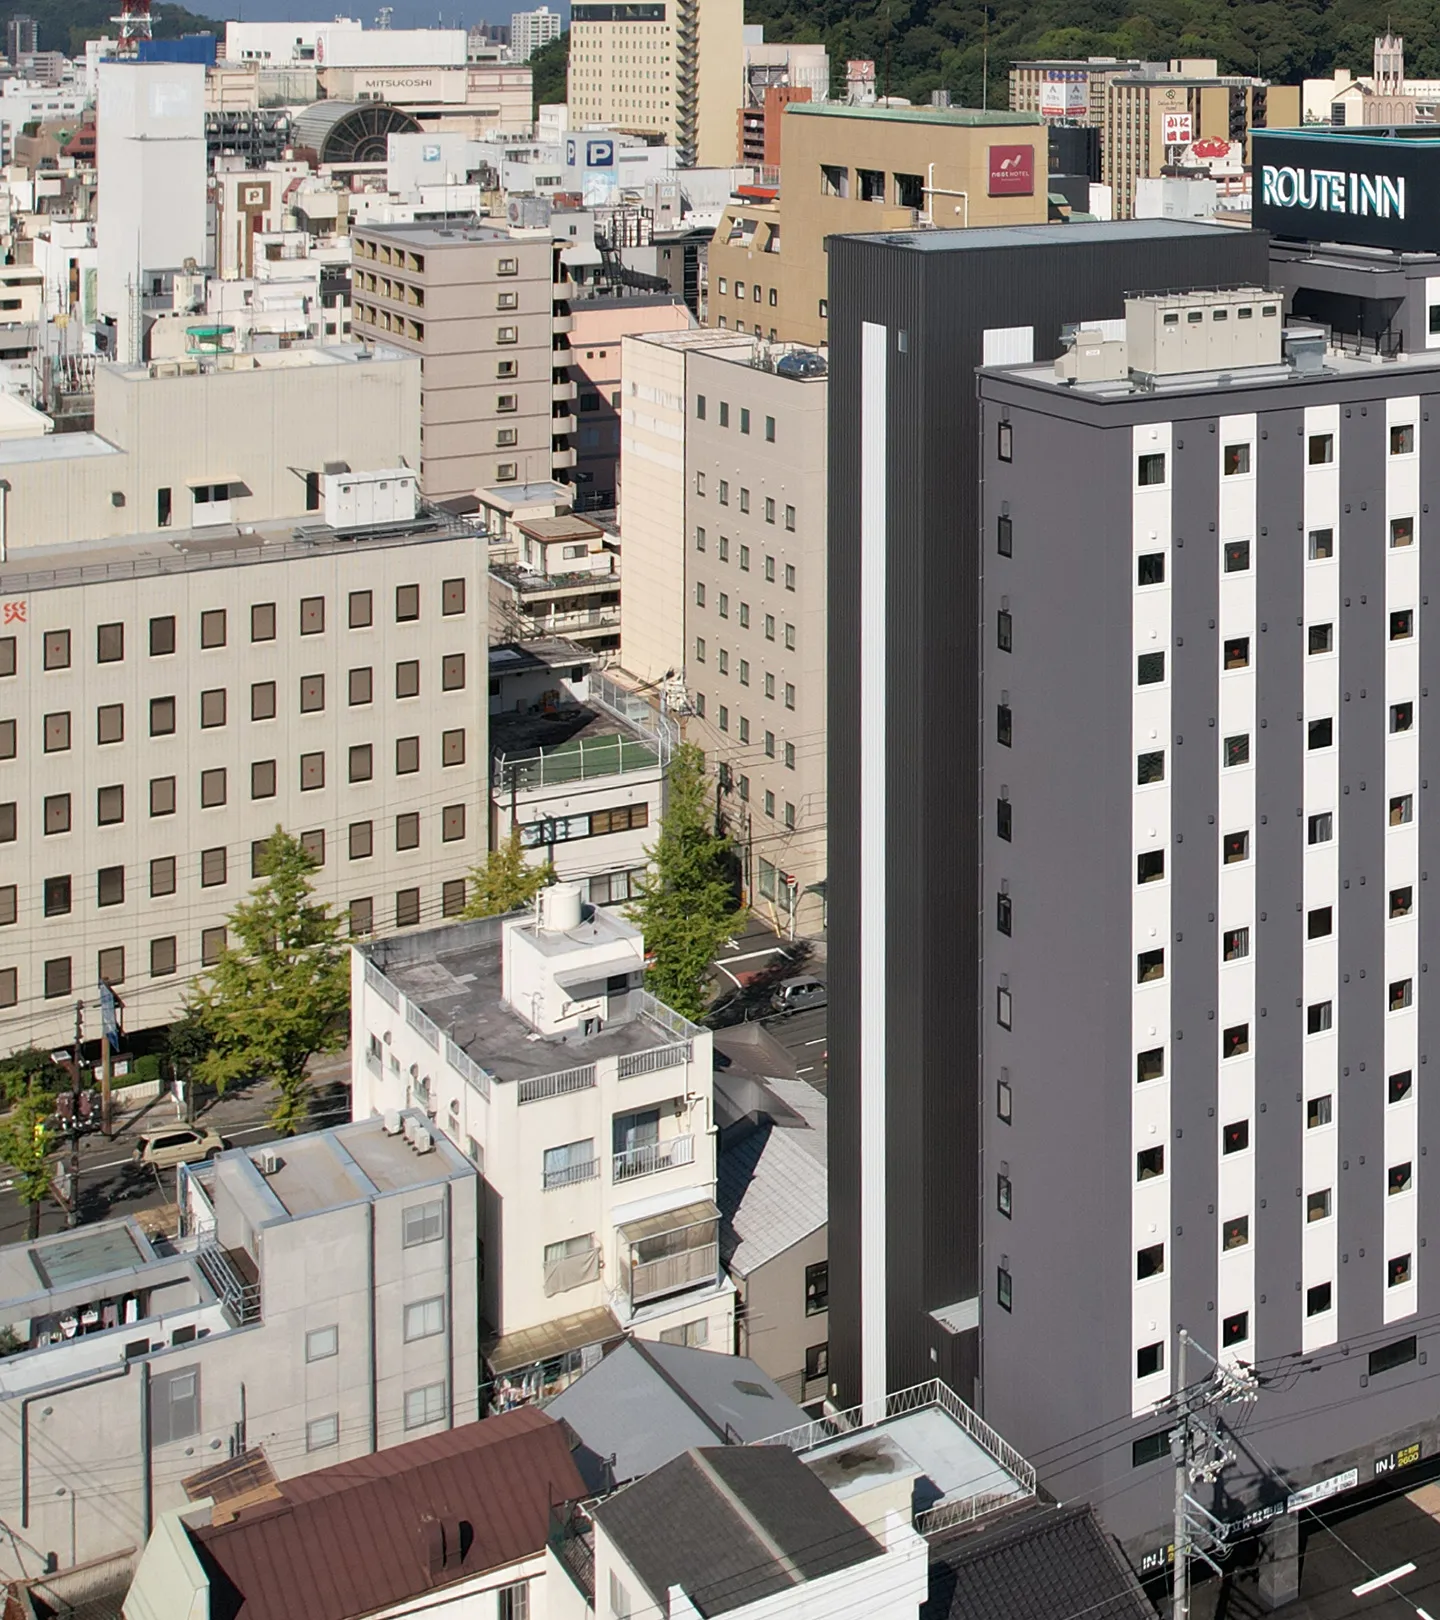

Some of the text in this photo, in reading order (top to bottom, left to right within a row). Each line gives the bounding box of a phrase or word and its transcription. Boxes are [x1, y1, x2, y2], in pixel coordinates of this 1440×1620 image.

[365, 79, 432, 88] MITSUKOSHI
[590, 142, 612, 164] P
[1262, 165, 1405, 220] ROUTE INN
[4, 600, 27, 624] 災
[1375, 1459, 1388, 1474] IN
[1142, 1553, 1157, 1570] IN
